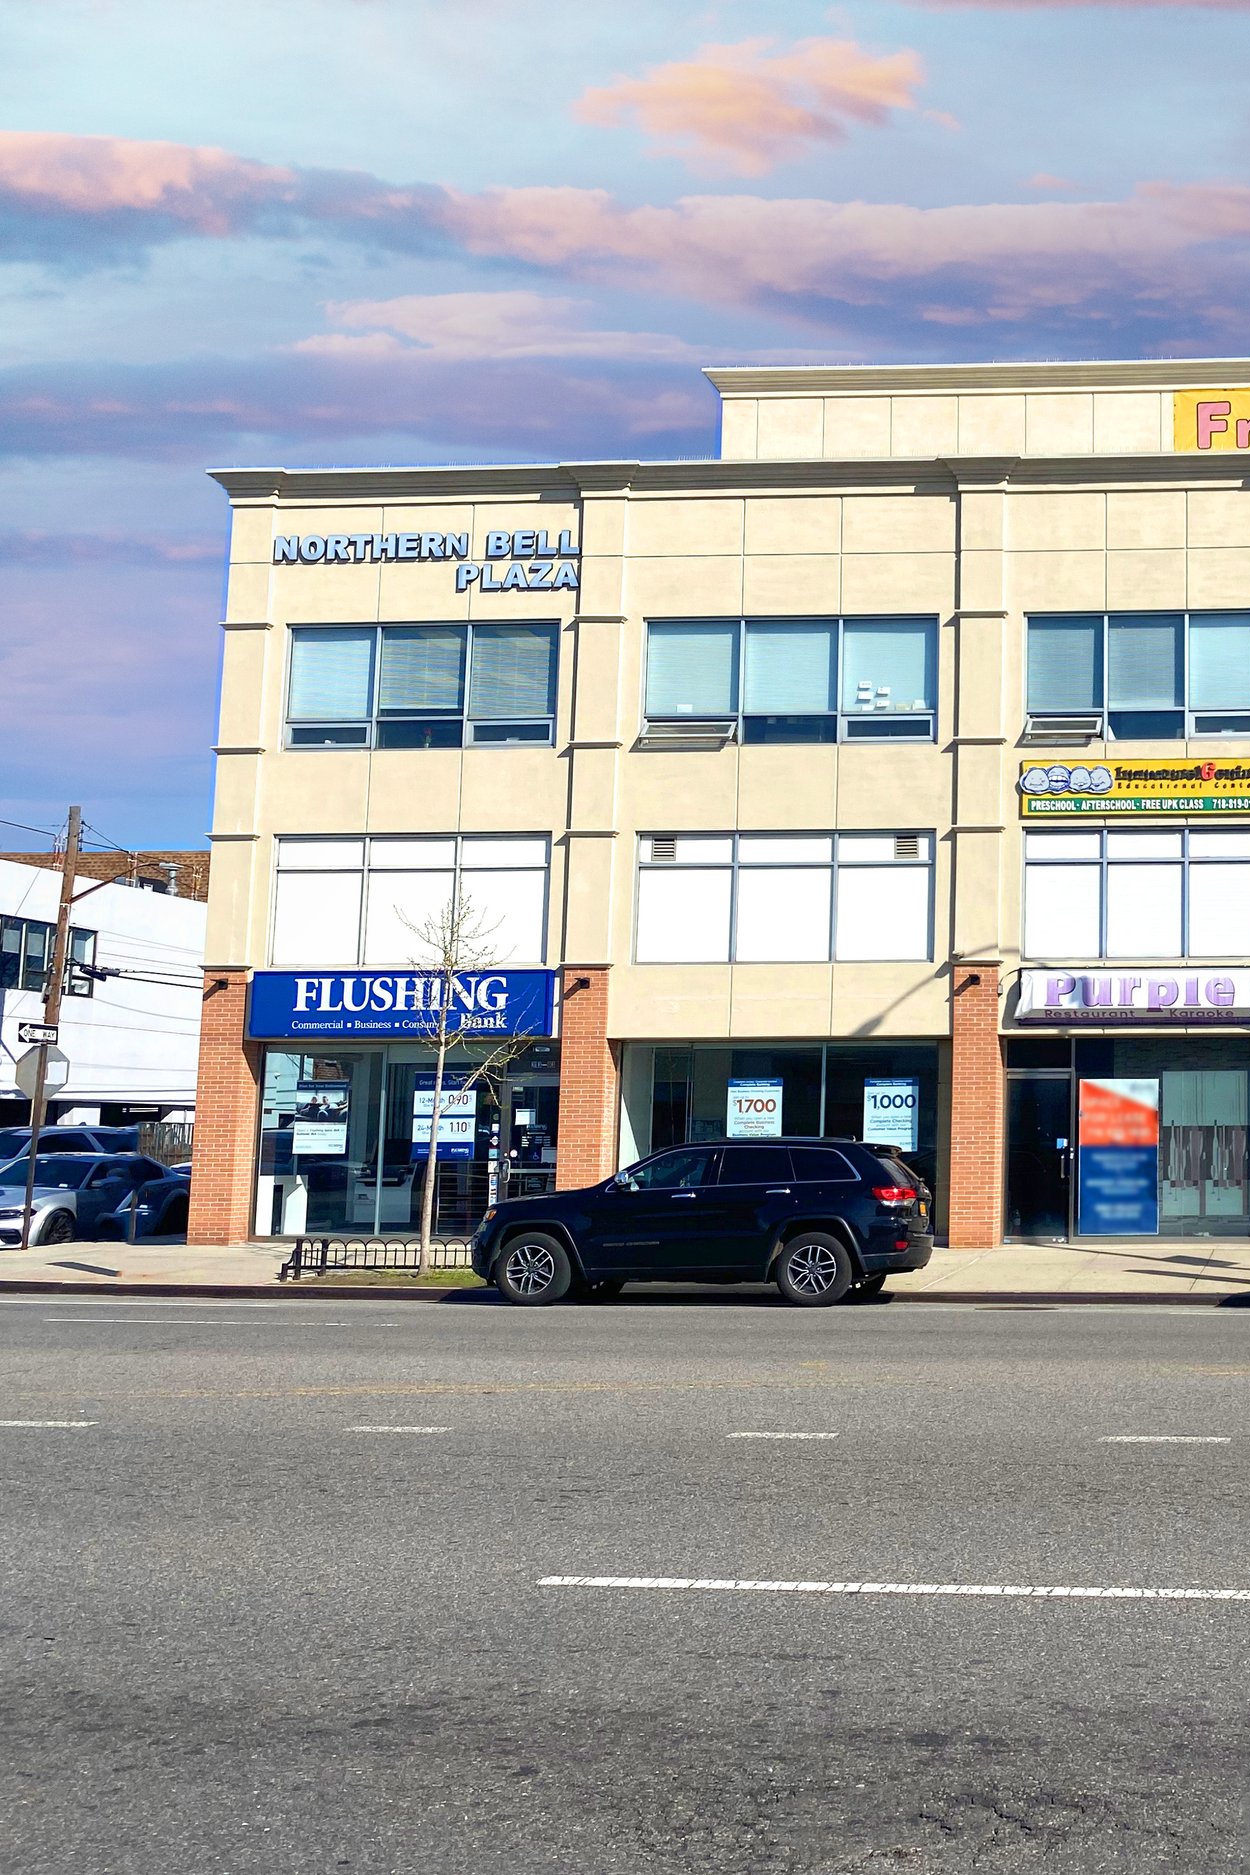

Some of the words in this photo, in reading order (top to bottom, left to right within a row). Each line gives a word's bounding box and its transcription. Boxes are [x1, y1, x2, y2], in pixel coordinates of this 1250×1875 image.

[274, 531, 469, 563] NORTHERN
[486, 529, 580, 558] BELL
[456, 562, 580, 593] PLAZA
[1030, 800, 1076, 811] PRESCHOOL
[1080, 799, 1136, 811] AFTERSCHOOL
[1141, 799, 1160, 810] FREE
[1161, 798, 1178, 809] UPK
[1179, 798, 1204, 809] CLASS
[292, 976, 509, 1013] FLUSHING
[1044, 976, 1236, 1013] Purple
[459, 1012, 508, 1029] Bank
[1044, 1009, 1136, 1018] Restaurant
[1168, 1008, 1235, 1018] Karaoke
[24, 1029, 36, 1037] ONE
[291, 1020, 343, 1030] Commercial
[354, 1020, 391, 1030] Business
[402, 1020, 446, 1030] Consum
